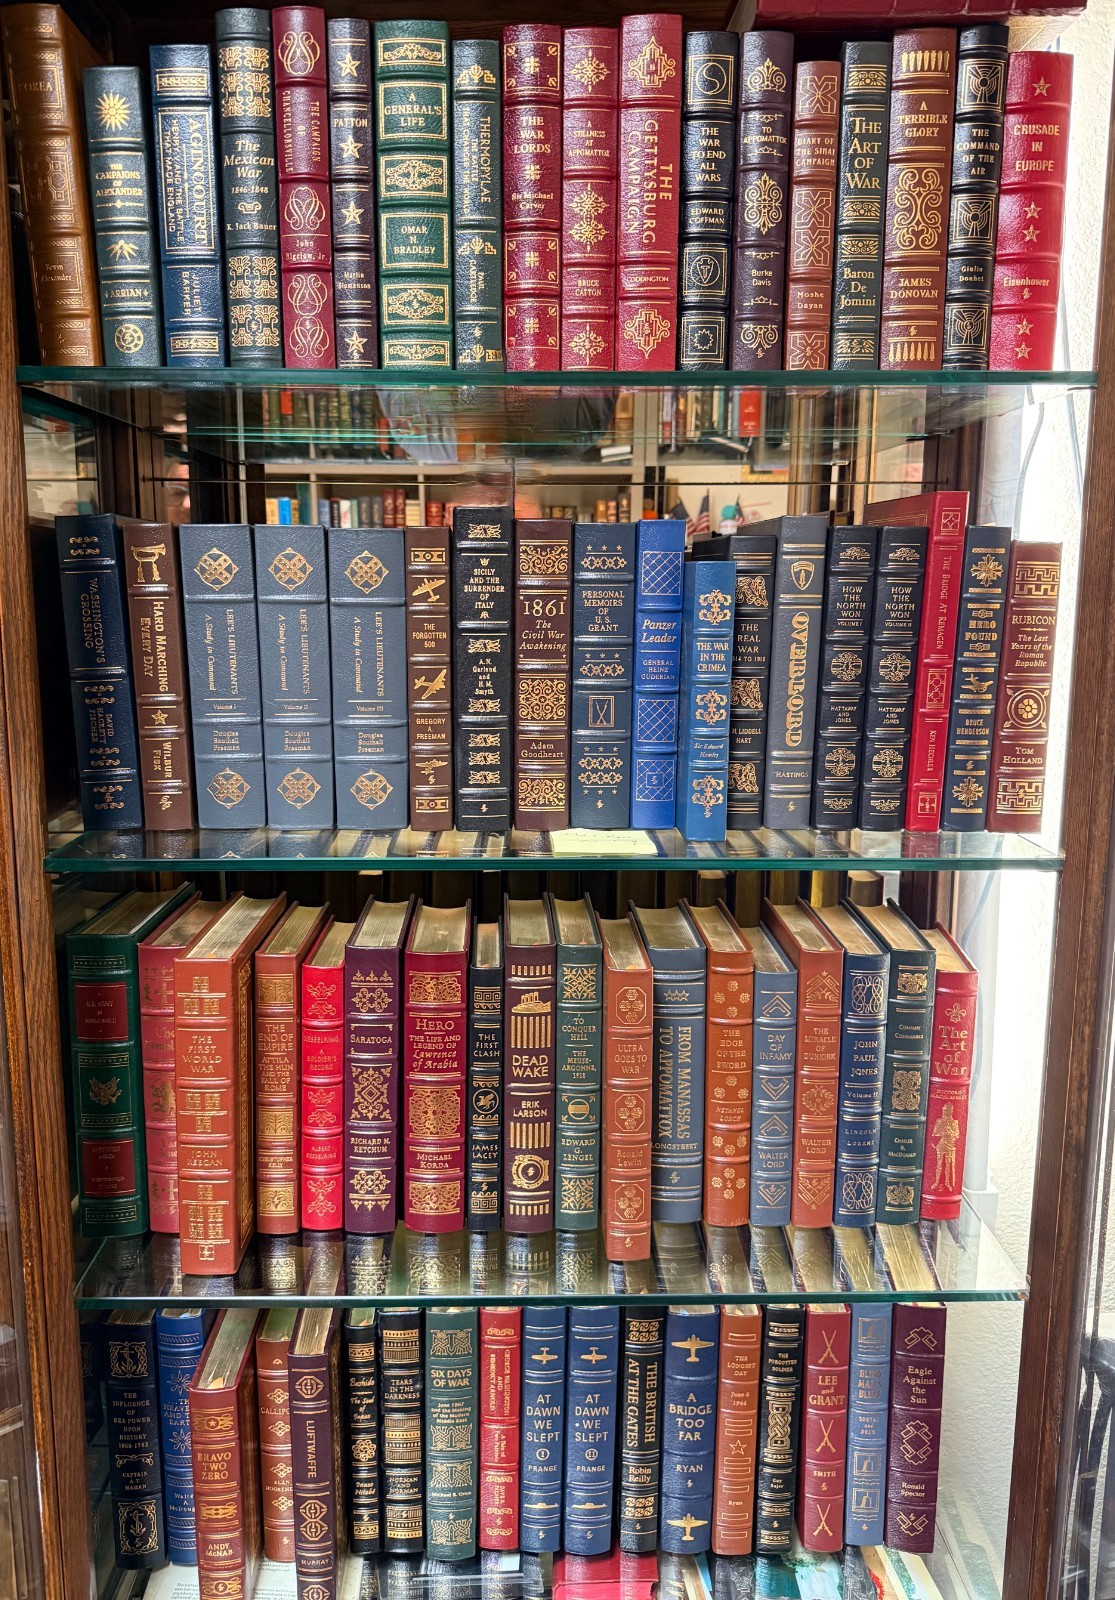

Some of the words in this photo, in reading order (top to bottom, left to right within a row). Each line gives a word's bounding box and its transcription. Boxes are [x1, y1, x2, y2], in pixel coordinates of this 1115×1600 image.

[409, 93, 416, 101] A
[384, 105, 442, 115] GENERAL'S
[920, 101, 927, 111] A
[334, 119, 368, 128] PATTON
[401, 118, 425, 126] LIFE
[521, 117, 544, 126] THE
[897, 115, 948, 124] TERRIBLE
[850, 117, 882, 134] THE
[1014, 125, 1060, 136] CRUSADE
[520, 130, 544, 139] WAR
[905, 127, 939, 137] GLORY
[235, 140, 260, 151] The
[699, 139, 720, 147] WAR
[848, 138, 882, 154] ART
[1032, 142, 1042, 152] IN
[514, 144, 551, 154] LORDS
[479, 116, 491, 203] THERMOPYLAE
[692, 151, 705, 159] TO
[707, 151, 726, 159] END
[224, 155, 275, 167] Mexican
[854, 158, 874, 168] OF
[1016, 160, 1054, 171] EUROPE
[700, 163, 717, 171] ALL
[237, 167, 262, 178] War
[695, 173, 721, 182] WARS
[627, 130, 641, 233] CAMPAIGN
[643, 120, 658, 243] GETTYSBURG
[659, 164, 673, 200] THE
[845, 173, 881, 189] WAR
[410, 236, 418, 244] N.
[394, 246, 435, 254] BRADLEY
[751, 269, 773, 277] Burke
[843, 268, 874, 279] Baron
[752, 278, 771, 286] Davis
[898, 278, 932, 287] JAMES
[1003, 277, 1050, 287] Eisenhower
[851, 282, 867, 293] De
[890, 289, 938, 299] DONOVAN
[840, 295, 876, 309] Jomini
[473, 568, 495, 576] SICILY
[464, 585, 505, 593] SURRENDER
[475, 601, 495, 609] ITALY
[523, 599, 566, 617] 1861
[153, 602, 165, 632] HARD
[1012, 615, 1056, 625] RUBICON
[423, 623, 436, 631] THE
[536, 620, 552, 629] The
[588, 624, 618, 632] GRANT
[642, 620, 676, 630] Panzer
[140, 618, 152, 653] EVERY
[521, 630, 545, 639] Civil
[548, 631, 565, 639] War
[641, 633, 676, 643] Leader
[519, 642, 567, 652] Awakening
[142, 656, 154, 678] DAY
[155, 633, 169, 692] MARCHING
[697, 664, 726, 672] CRIMEA
[786, 612, 810, 747] OVERLORD
[530, 742, 554, 750] Adam
[521, 750, 563, 758] Goodheart
[1003, 756, 1043, 764] HOLLAND
[415, 1019, 454, 1031] HERO
[478, 1033, 496, 1041] THE
[660, 1026, 673, 1045] TO
[939, 1026, 969, 1038] The
[191, 1036, 212, 1044] THE
[350, 1034, 392, 1044] SARATOGA
[188, 1045, 216, 1053] FIRST
[678, 1026, 691, 1063] FROM
[939, 1040, 966, 1051] Art
[182, 1054, 222, 1063] WORLD
[512, 1055, 549, 1066] DEAD
[759, 1052, 792, 1060] INFAMY
[944, 1052, 960, 1063] of
[191, 1064, 214, 1073] WAR
[512, 1067, 549, 1077] WAKE
[935, 1062, 966, 1076] War
[658, 1049, 673, 1139] APPOMATTOX
[677, 1069, 691, 1139] MANASSAS
[513, 1109, 548, 1117] LARSON
[449, 1369, 472, 1377] DAYS
[628, 1359, 640, 1377] AT
[908, 1366, 932, 1376] Eagle
[646, 1362, 657, 1389] THE
[818, 1376, 838, 1385] LEE
[903, 1376, 936, 1385] Against
[433, 1379, 447, 1387] OF
[448, 1378, 469, 1386] WAR
[627, 1379, 639, 1403] THE
[912, 1386, 926, 1394] the
[385, 1392, 420, 1400] DARKNESS
[537, 1395, 551, 1403] AT
[585, 1395, 600, 1403] AT
[687, 1393, 696, 1402] A
[808, 1395, 845, 1406] GRANT
[910, 1395, 927, 1404] Sun
[526, 1406, 560, 1416] DAWN
[575, 1406, 609, 1416] DAWN
[669, 1405, 712, 1414] BRIDGE
[644, 1391, 657, 1443] BRITISH
[534, 1420, 552, 1428] WE
[582, 1420, 600, 1428] WE
[626, 1405, 639, 1447] GATES
[676, 1419, 705, 1428] TOO
[526, 1432, 560, 1442] SLEPT
[575, 1432, 609, 1442] SLEPT
[678, 1432, 701, 1441] FAR
[305, 1421, 318, 1478] LUFTWAFFE
[198, 1452, 232, 1462] BRAVO
[202, 1462, 227, 1471] TWO
[202, 1471, 229, 1481] ZERO
[629, 1475, 651, 1483] Reilly
[902, 1482, 925, 1490] Ronald
[900, 1490, 925, 1498] Spector
